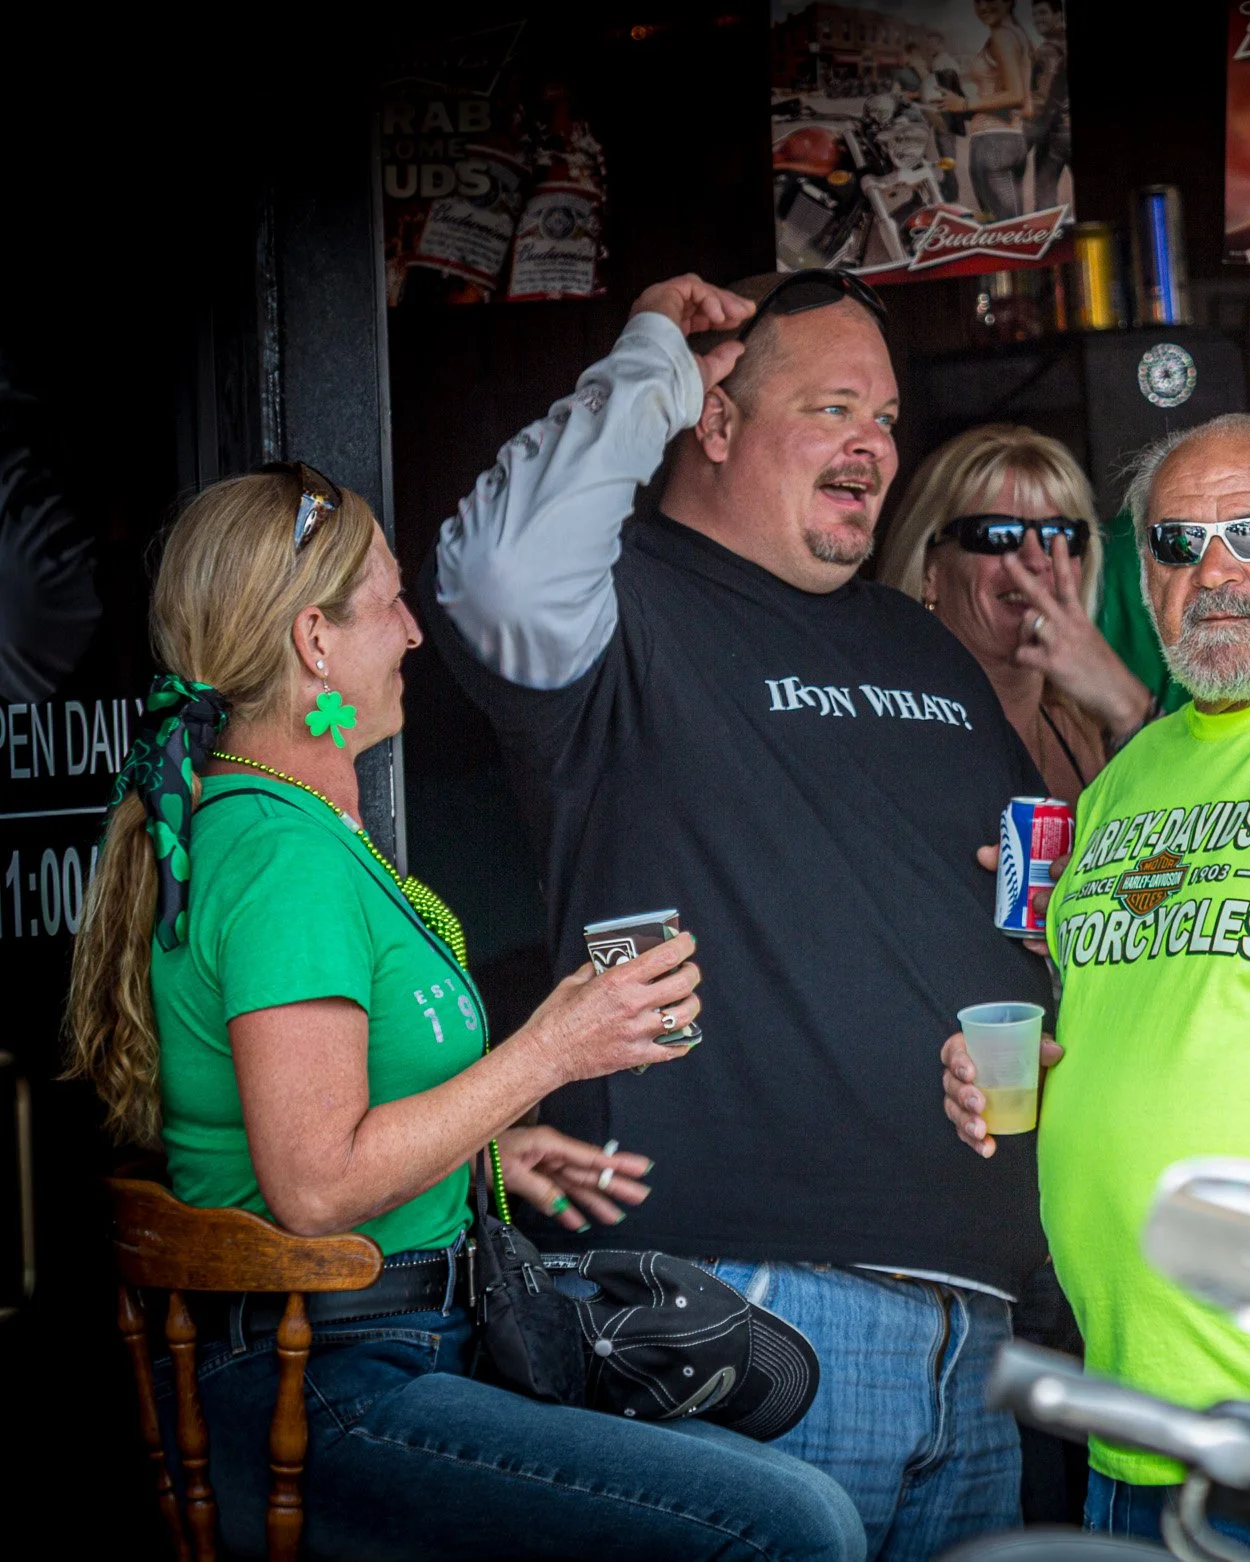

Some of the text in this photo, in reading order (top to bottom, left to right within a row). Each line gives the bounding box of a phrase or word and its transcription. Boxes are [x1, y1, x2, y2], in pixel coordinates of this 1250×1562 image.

[909, 223, 1066, 252] Budweiser
[858, 684, 974, 732] WHAT?
[1078, 863, 1231, 898] SINCE 1903
[1121, 870, 1184, 890] HARLEY-DAVIDSON
[1130, 890, 1165, 912] CYCLES
